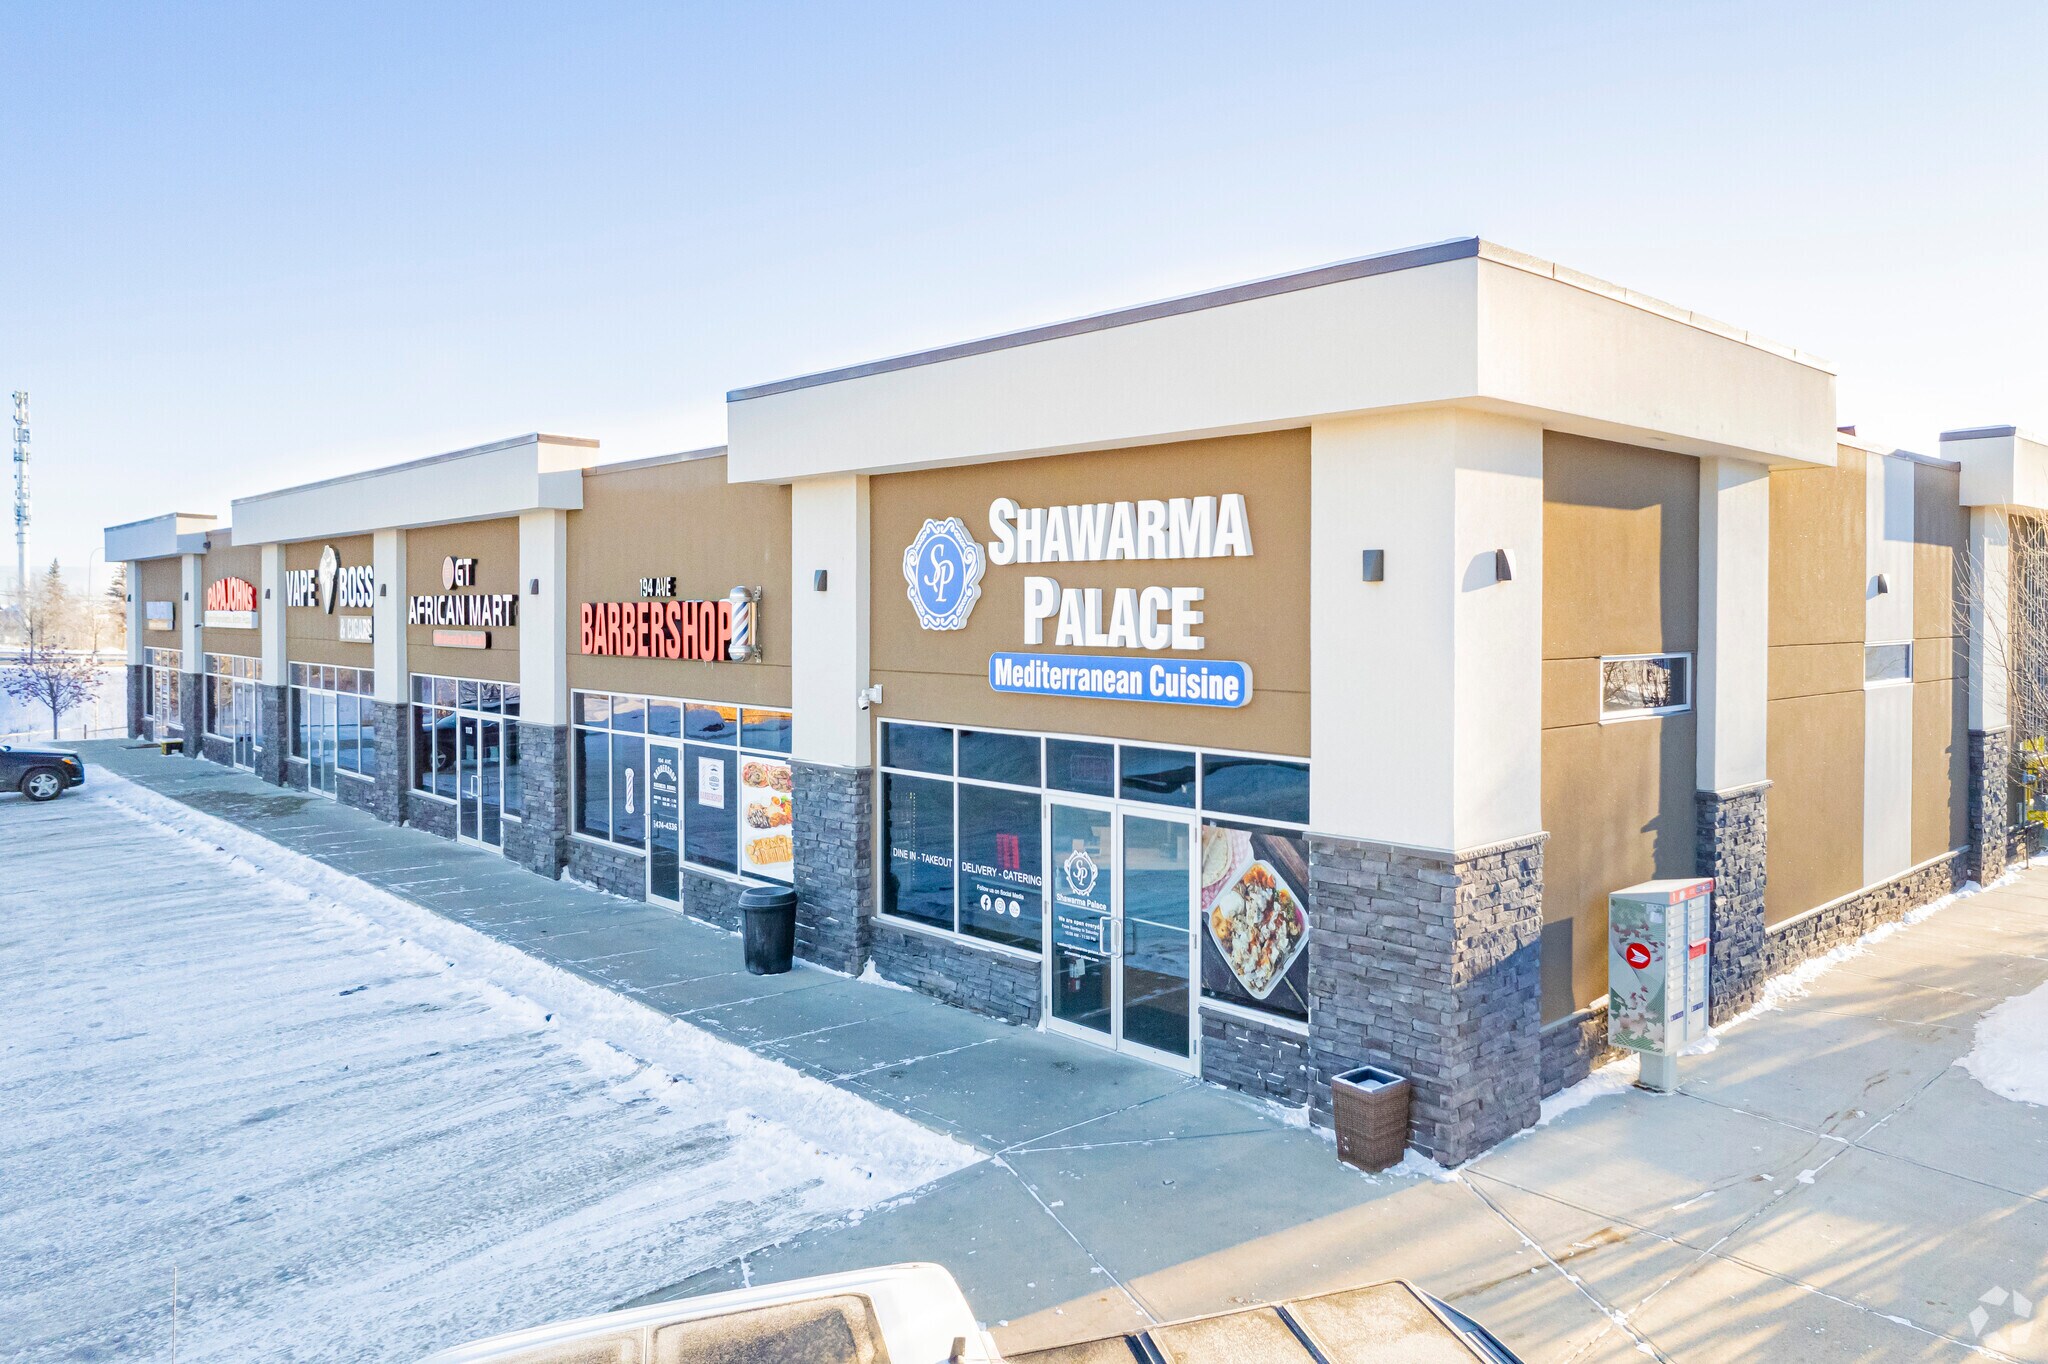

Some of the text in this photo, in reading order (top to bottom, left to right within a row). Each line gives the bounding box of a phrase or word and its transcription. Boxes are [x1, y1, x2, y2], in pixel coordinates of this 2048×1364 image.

[988, 494, 1254, 566] SHAWARMA
[286, 565, 374, 608] VAPE BOSS
[455, 558, 472, 587] GT
[640, 577, 671, 597] 194 AVE
[208, 578, 228, 611] PAPA
[227, 576, 253, 611] JOHNS
[408, 594, 513, 627] AFRICAN MART
[1024, 576, 1205, 651] PALACE
[581, 600, 733, 662] BARBERSHOP
[994, 657, 1240, 701] Mediterranean Cuisine
[892, 847, 909, 860] DINE
[909, 851, 917, 860] IN
[921, 853, 953, 868] TAKEOUT
[961, 861, 997, 878] DELIVERY
[1003, 870, 1042, 886] CATERING
[1056, 893, 1107, 911] Shawarma Palace
[1085, 922, 1105, 931] everydy
